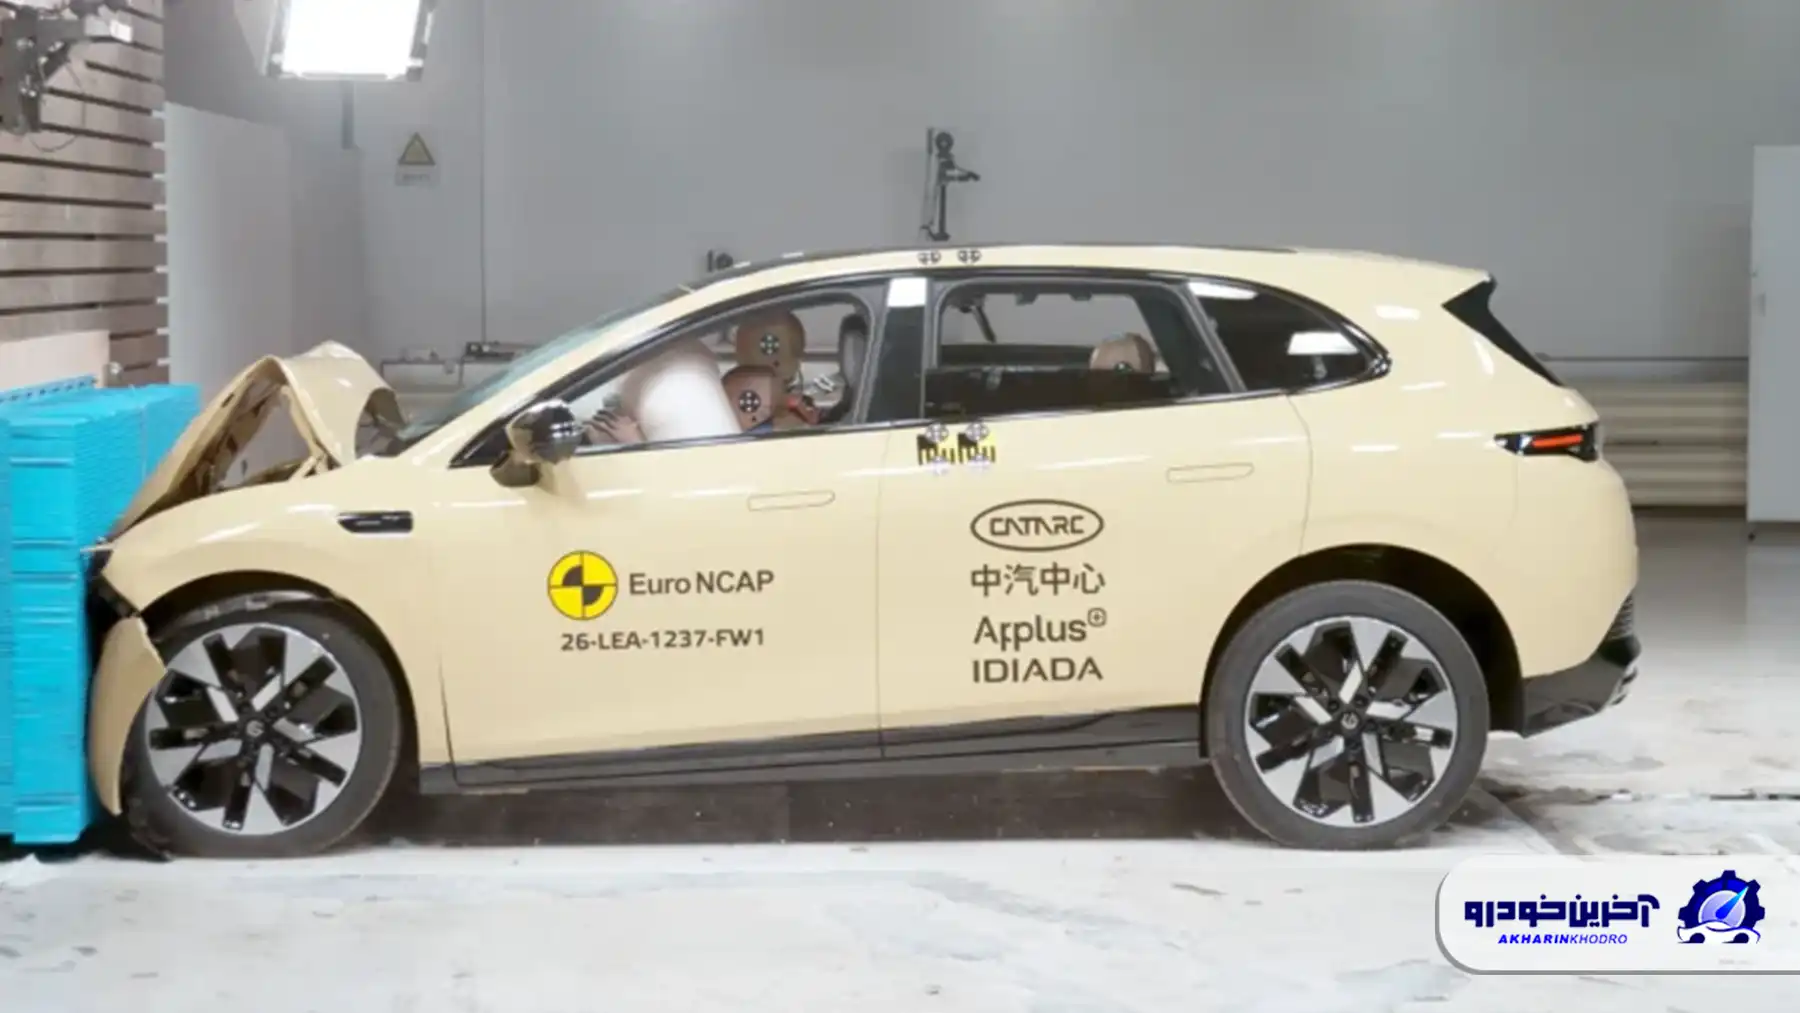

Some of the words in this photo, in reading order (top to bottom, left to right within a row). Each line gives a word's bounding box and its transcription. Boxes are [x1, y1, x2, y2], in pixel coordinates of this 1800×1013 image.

[628, 572, 691, 595] Euro
[696, 569, 775, 594] NCAP
[970, 562, 1105, 597] 中汽中心
[560, 628, 764, 651] 26-LEA-1237-FW1
[972, 656, 1103, 683] IDIADA
